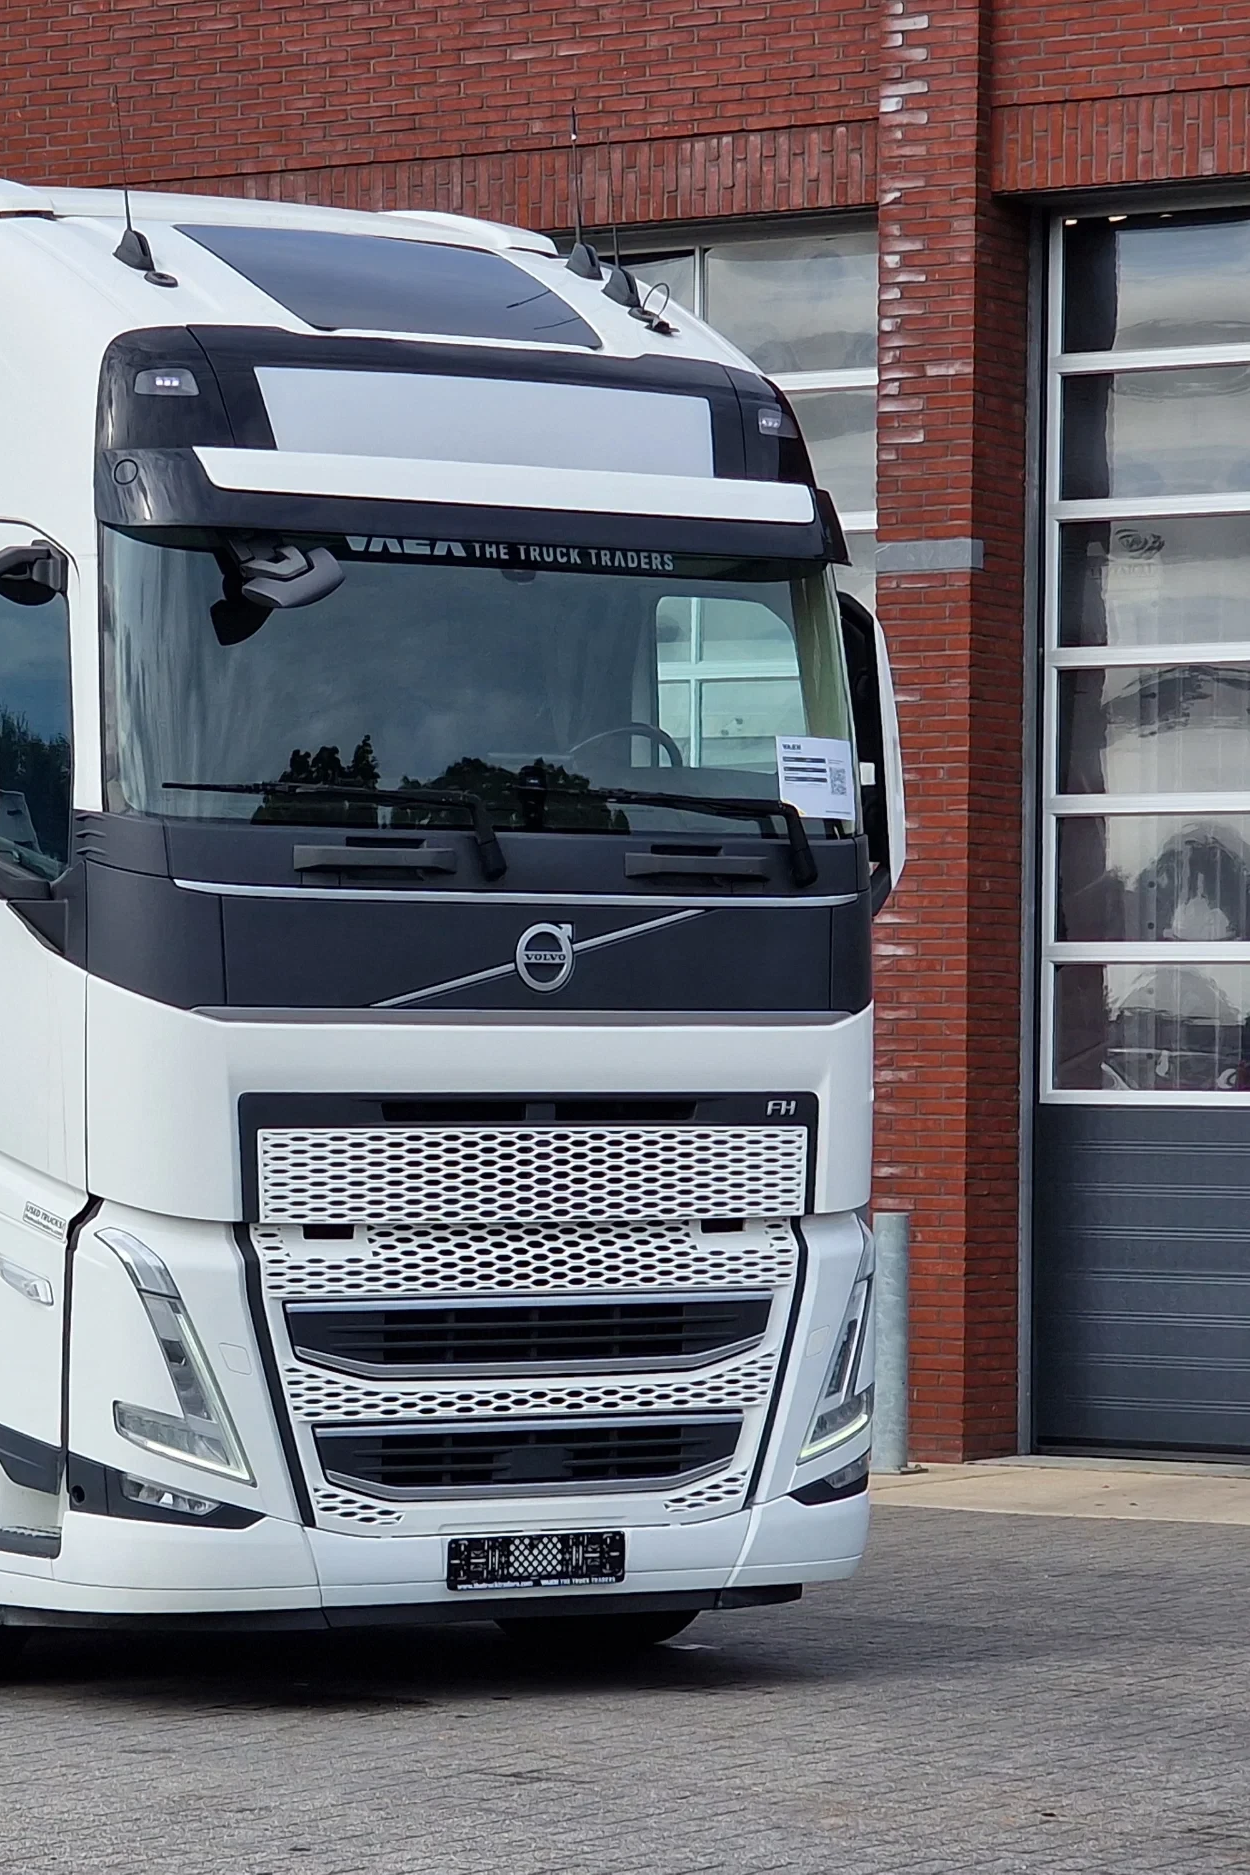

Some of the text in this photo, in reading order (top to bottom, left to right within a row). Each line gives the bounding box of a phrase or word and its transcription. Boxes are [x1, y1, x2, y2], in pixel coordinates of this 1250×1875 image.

[472, 543, 510, 560] THE
[517, 545, 582, 565] TRUCK
[588, 549, 674, 571] TRADERS
[524, 953, 566, 961] VOLVO
[766, 1100, 796, 1116] FH
